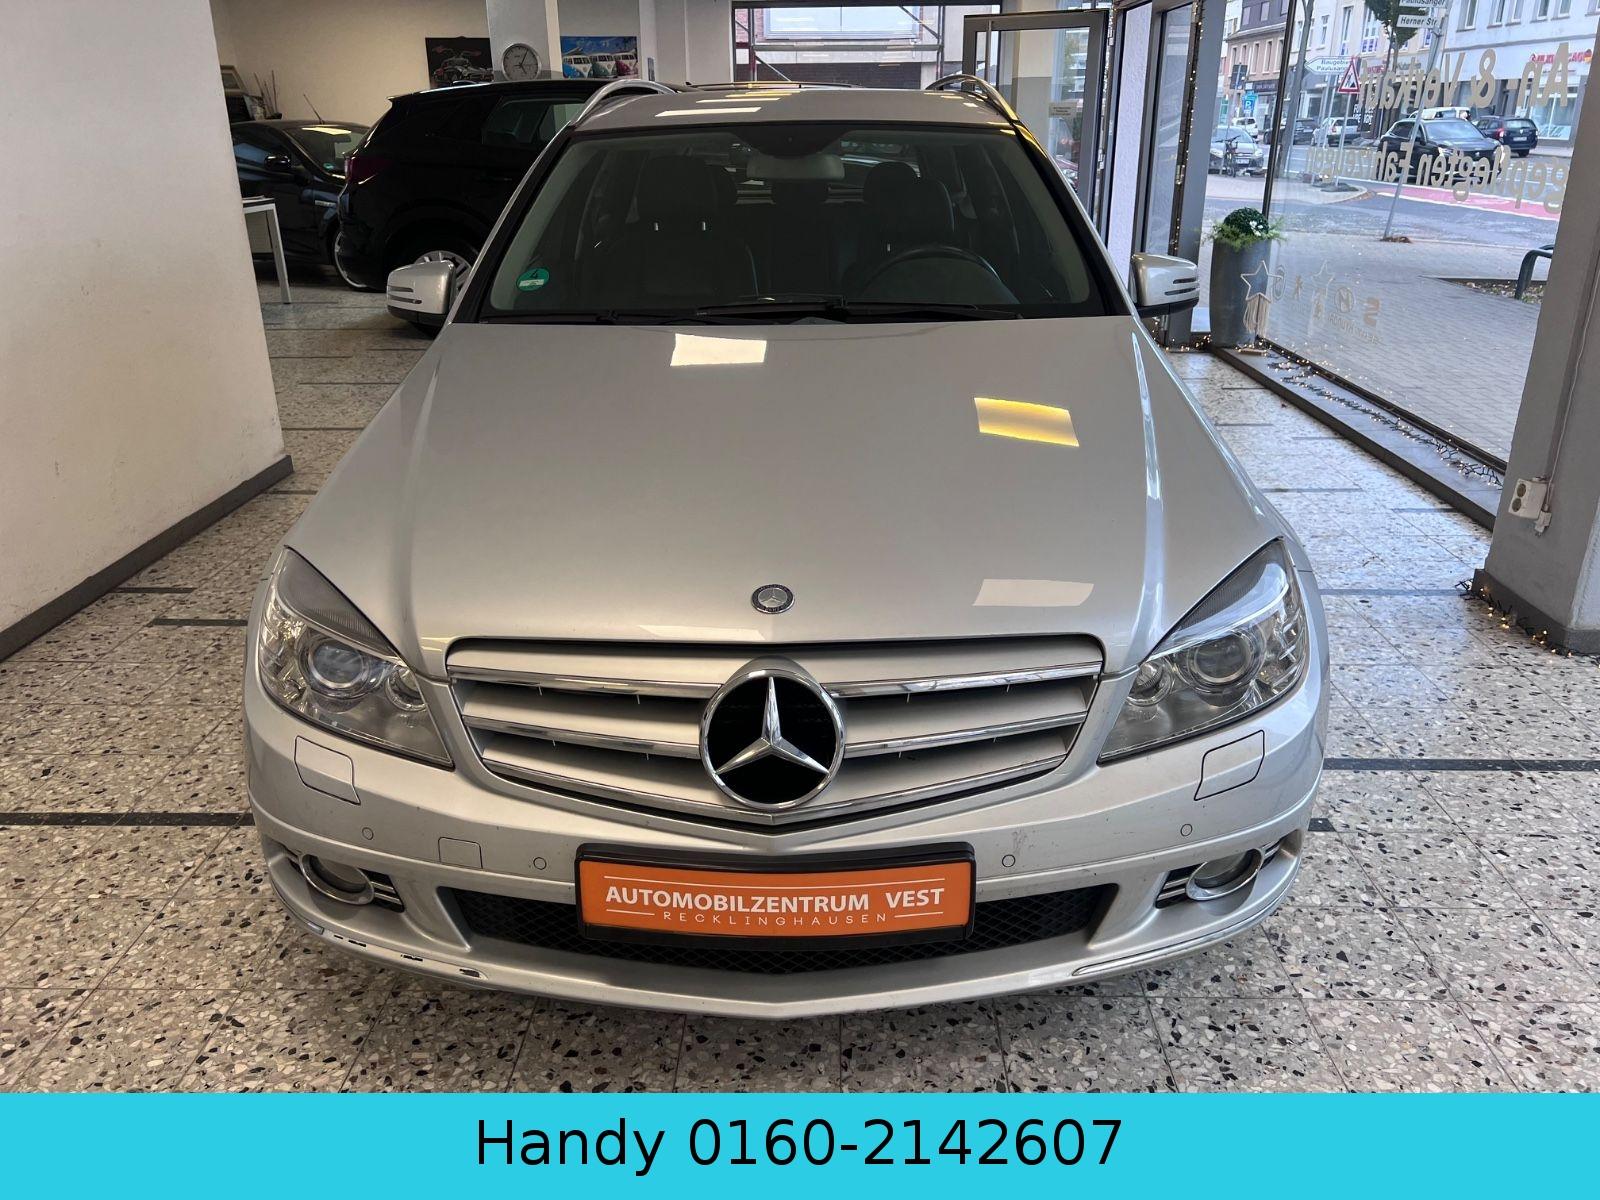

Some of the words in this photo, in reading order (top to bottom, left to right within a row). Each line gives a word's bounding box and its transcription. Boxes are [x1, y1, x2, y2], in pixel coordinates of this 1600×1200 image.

[1400, 16, 1425, 25] Herner
[605, 886, 869, 913] AUTOMOBILZENTRUM
[884, 888, 945, 908] VEST
[663, 910, 886, 927] RECKLINGHAUSEN
